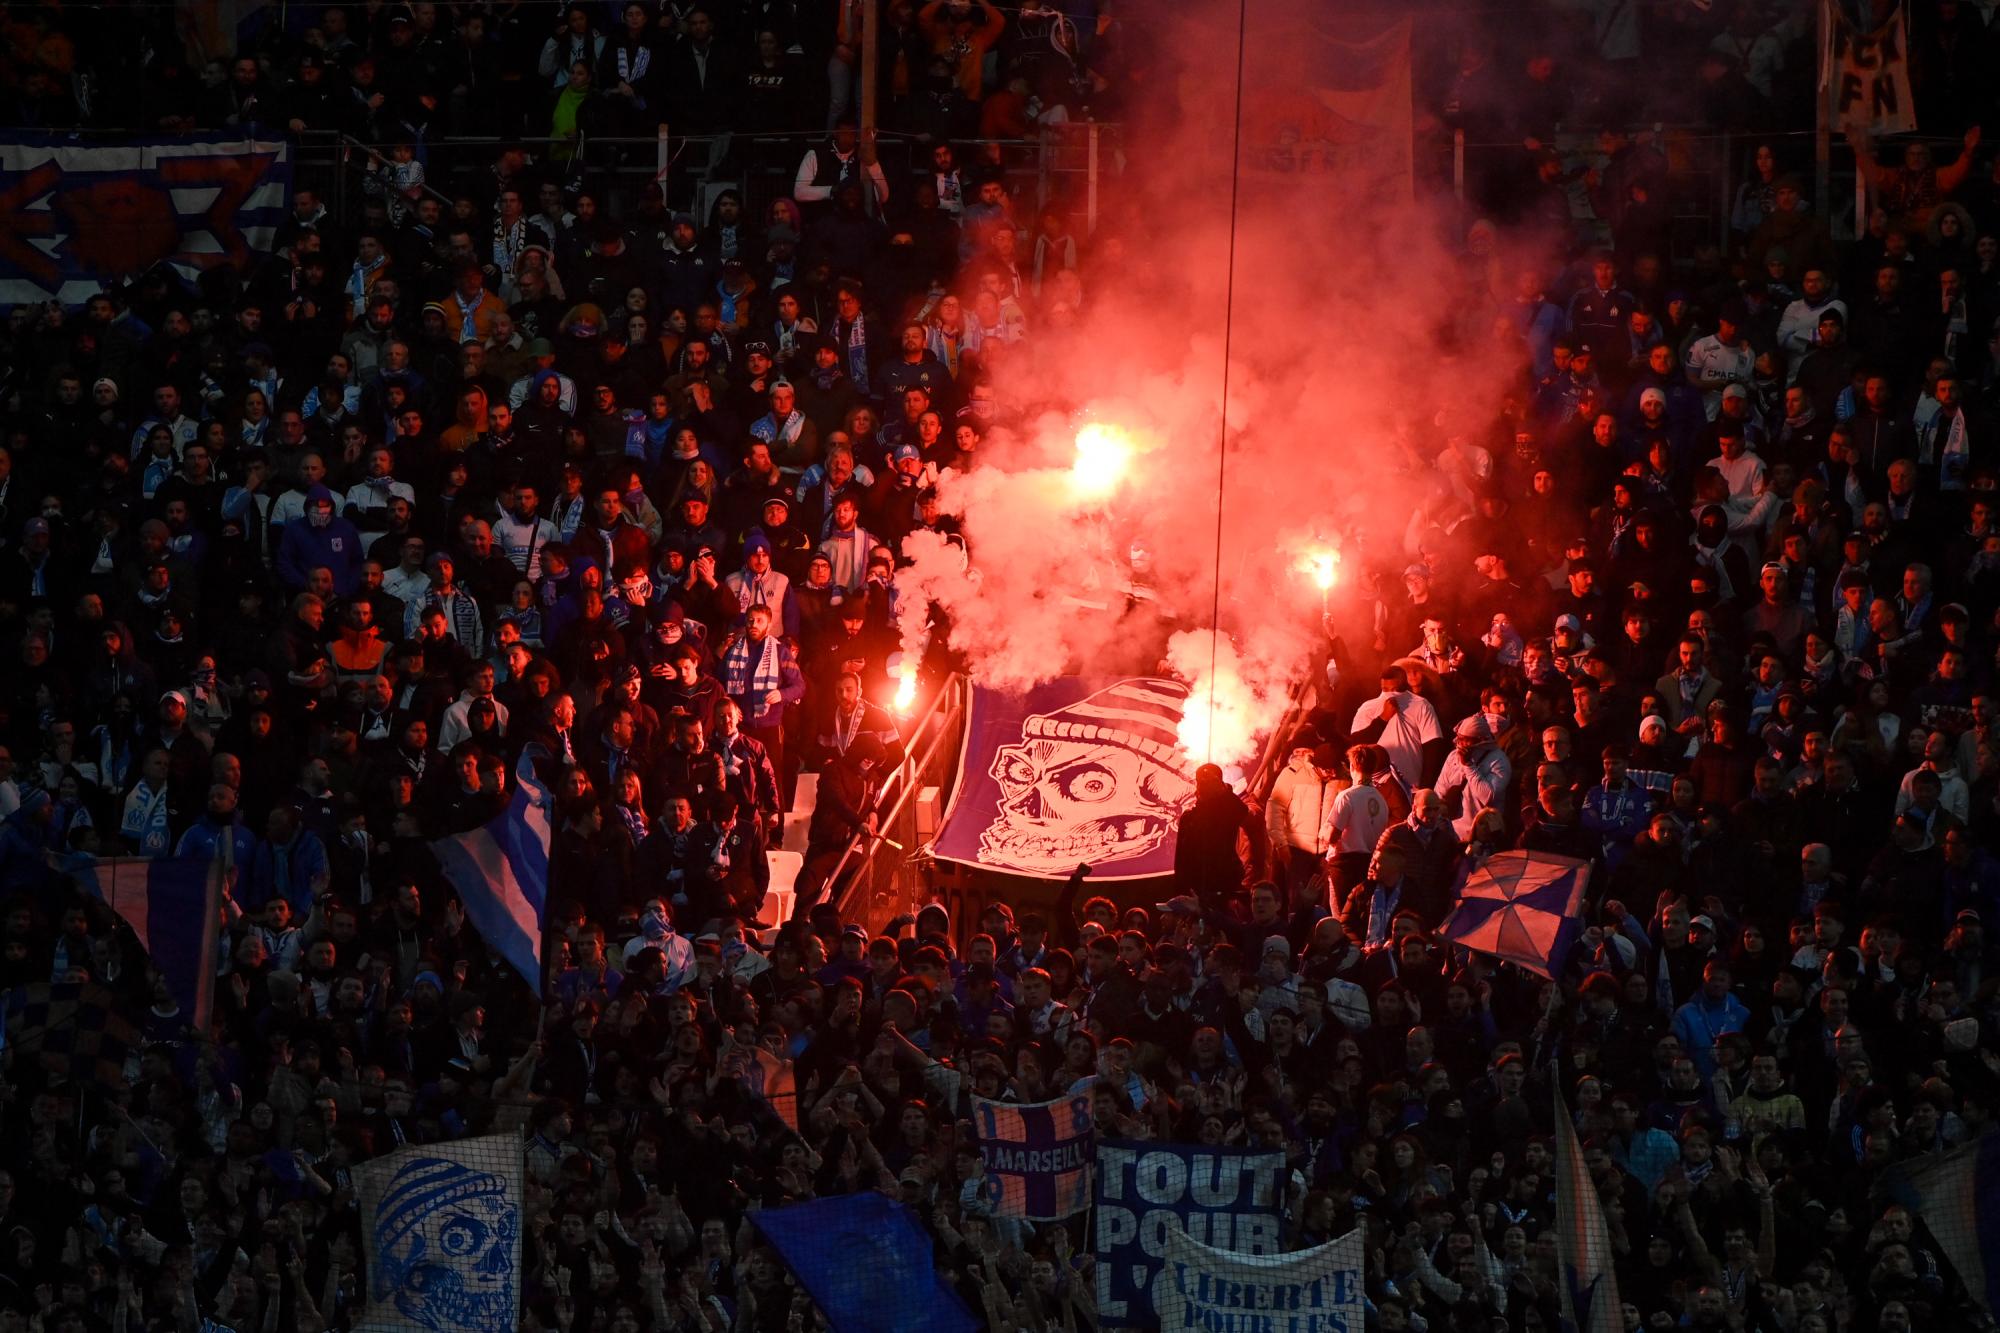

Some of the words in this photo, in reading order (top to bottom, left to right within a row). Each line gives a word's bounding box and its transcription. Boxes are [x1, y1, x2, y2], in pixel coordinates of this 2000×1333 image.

[1840, 72, 1898, 117] FN
[1096, 1144, 1287, 1208] TOUT
[1096, 1204, 1281, 1259] POUR
[1173, 1261, 1360, 1309] LIBERTE
[1288, 1311, 1349, 1333] LES
